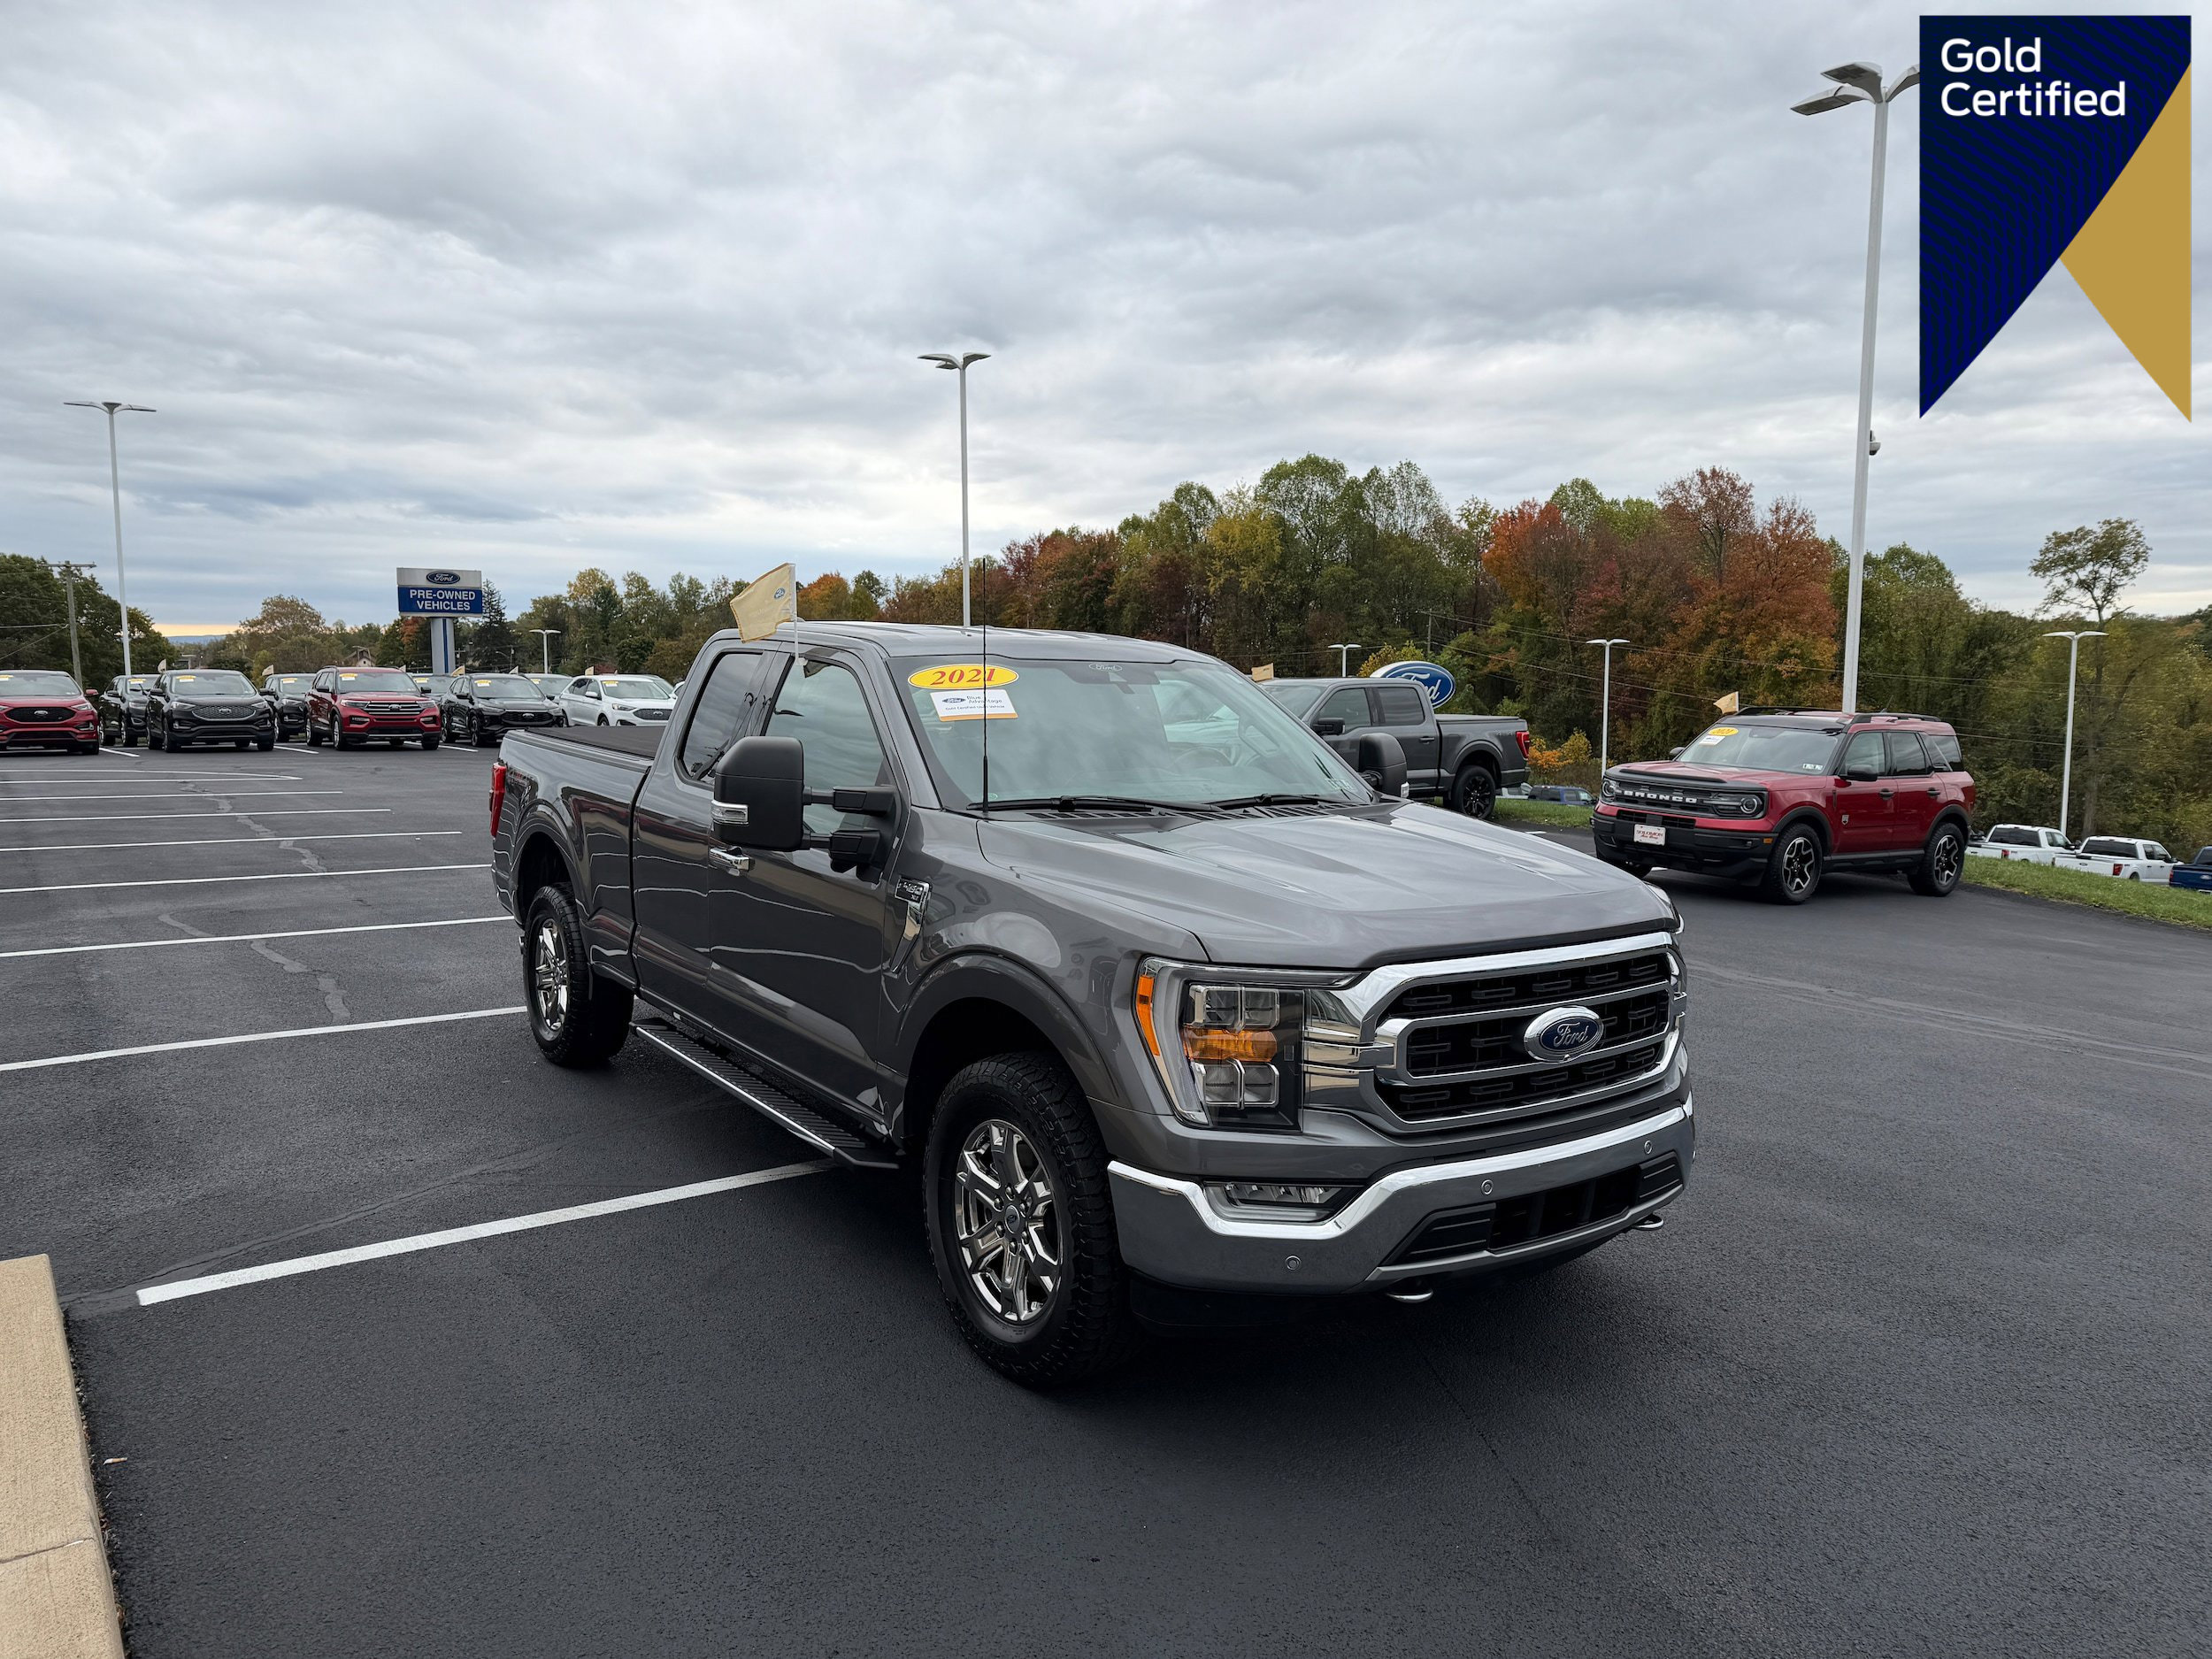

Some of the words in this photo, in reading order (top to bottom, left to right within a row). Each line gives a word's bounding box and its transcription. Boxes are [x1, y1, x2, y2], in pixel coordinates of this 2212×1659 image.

[434, 573, 454, 582] Ford
[410, 589, 475, 600] PRE-OWNED
[416, 600, 471, 611] VEHICLES
[930, 668, 995, 686] 2021
[1624, 790, 1697, 803] BRONCO
[1553, 1022, 1589, 1048] Ford
